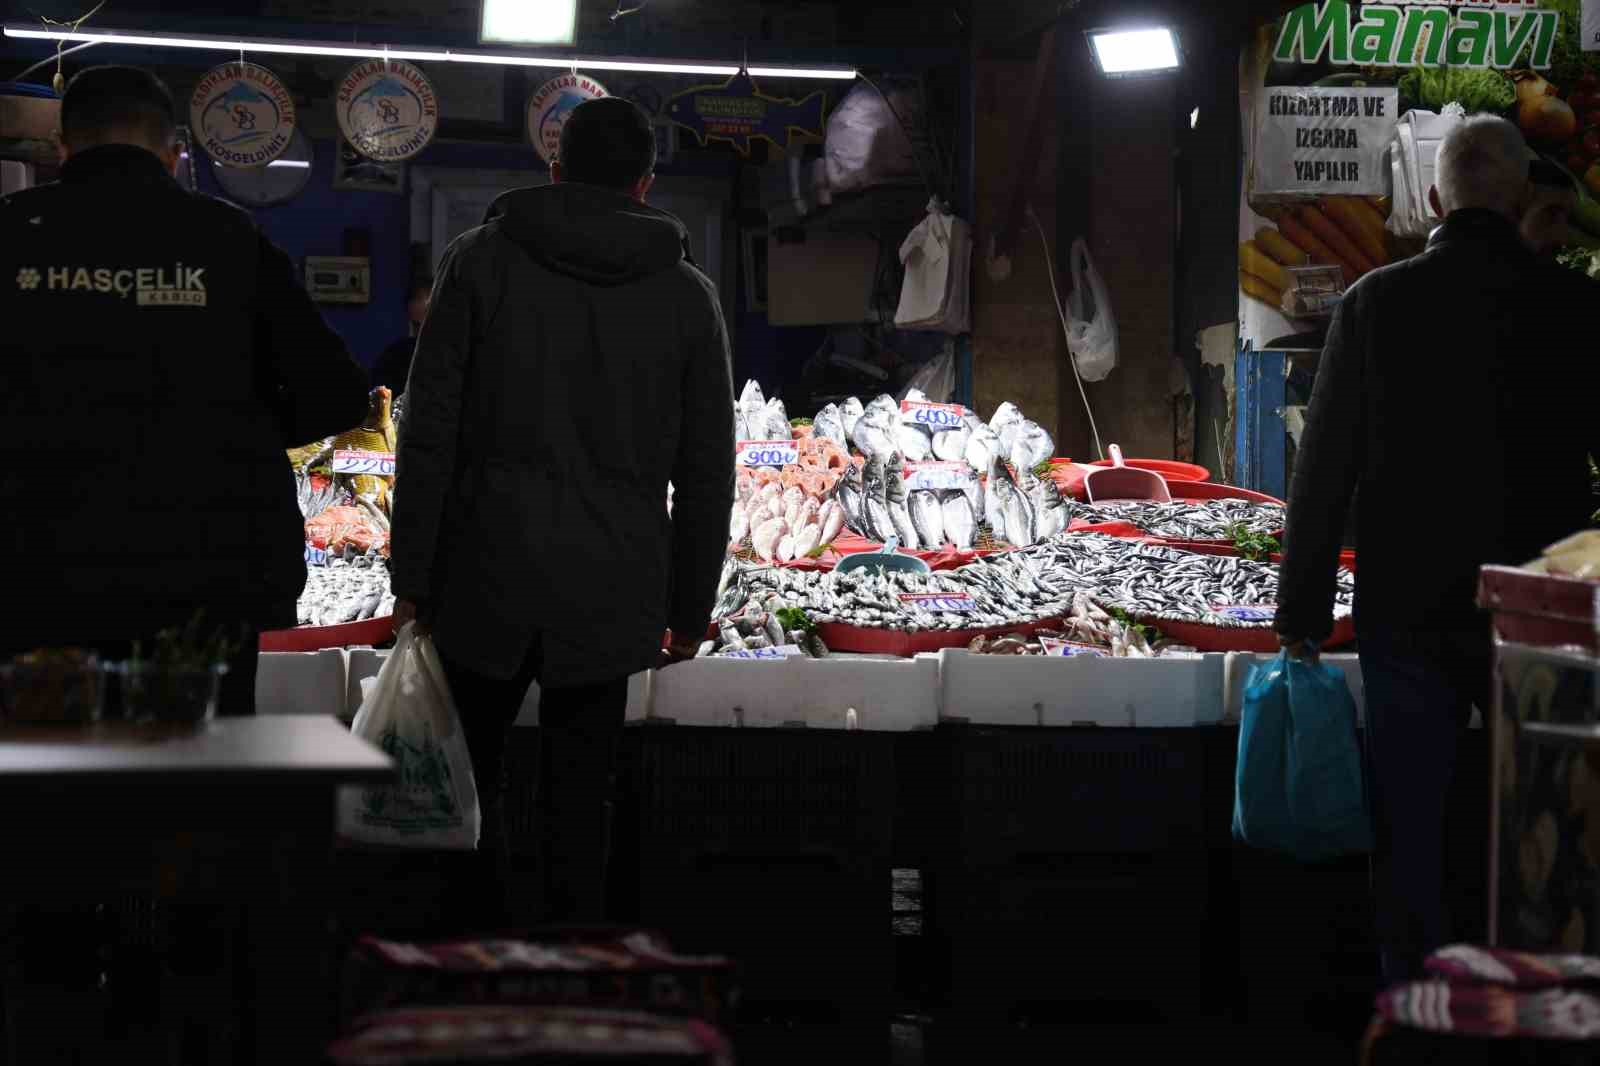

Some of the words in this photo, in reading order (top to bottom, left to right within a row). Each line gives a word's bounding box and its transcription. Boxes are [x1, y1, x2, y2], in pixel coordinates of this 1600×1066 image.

[1269, 95, 1360, 117] KIZARTMA
[1363, 96, 1385, 116] VE
[1296, 128, 1358, 149] IZGARA
[1294, 160, 1359, 182] YAPILIR
[48, 262, 206, 298] HASÇELİK
